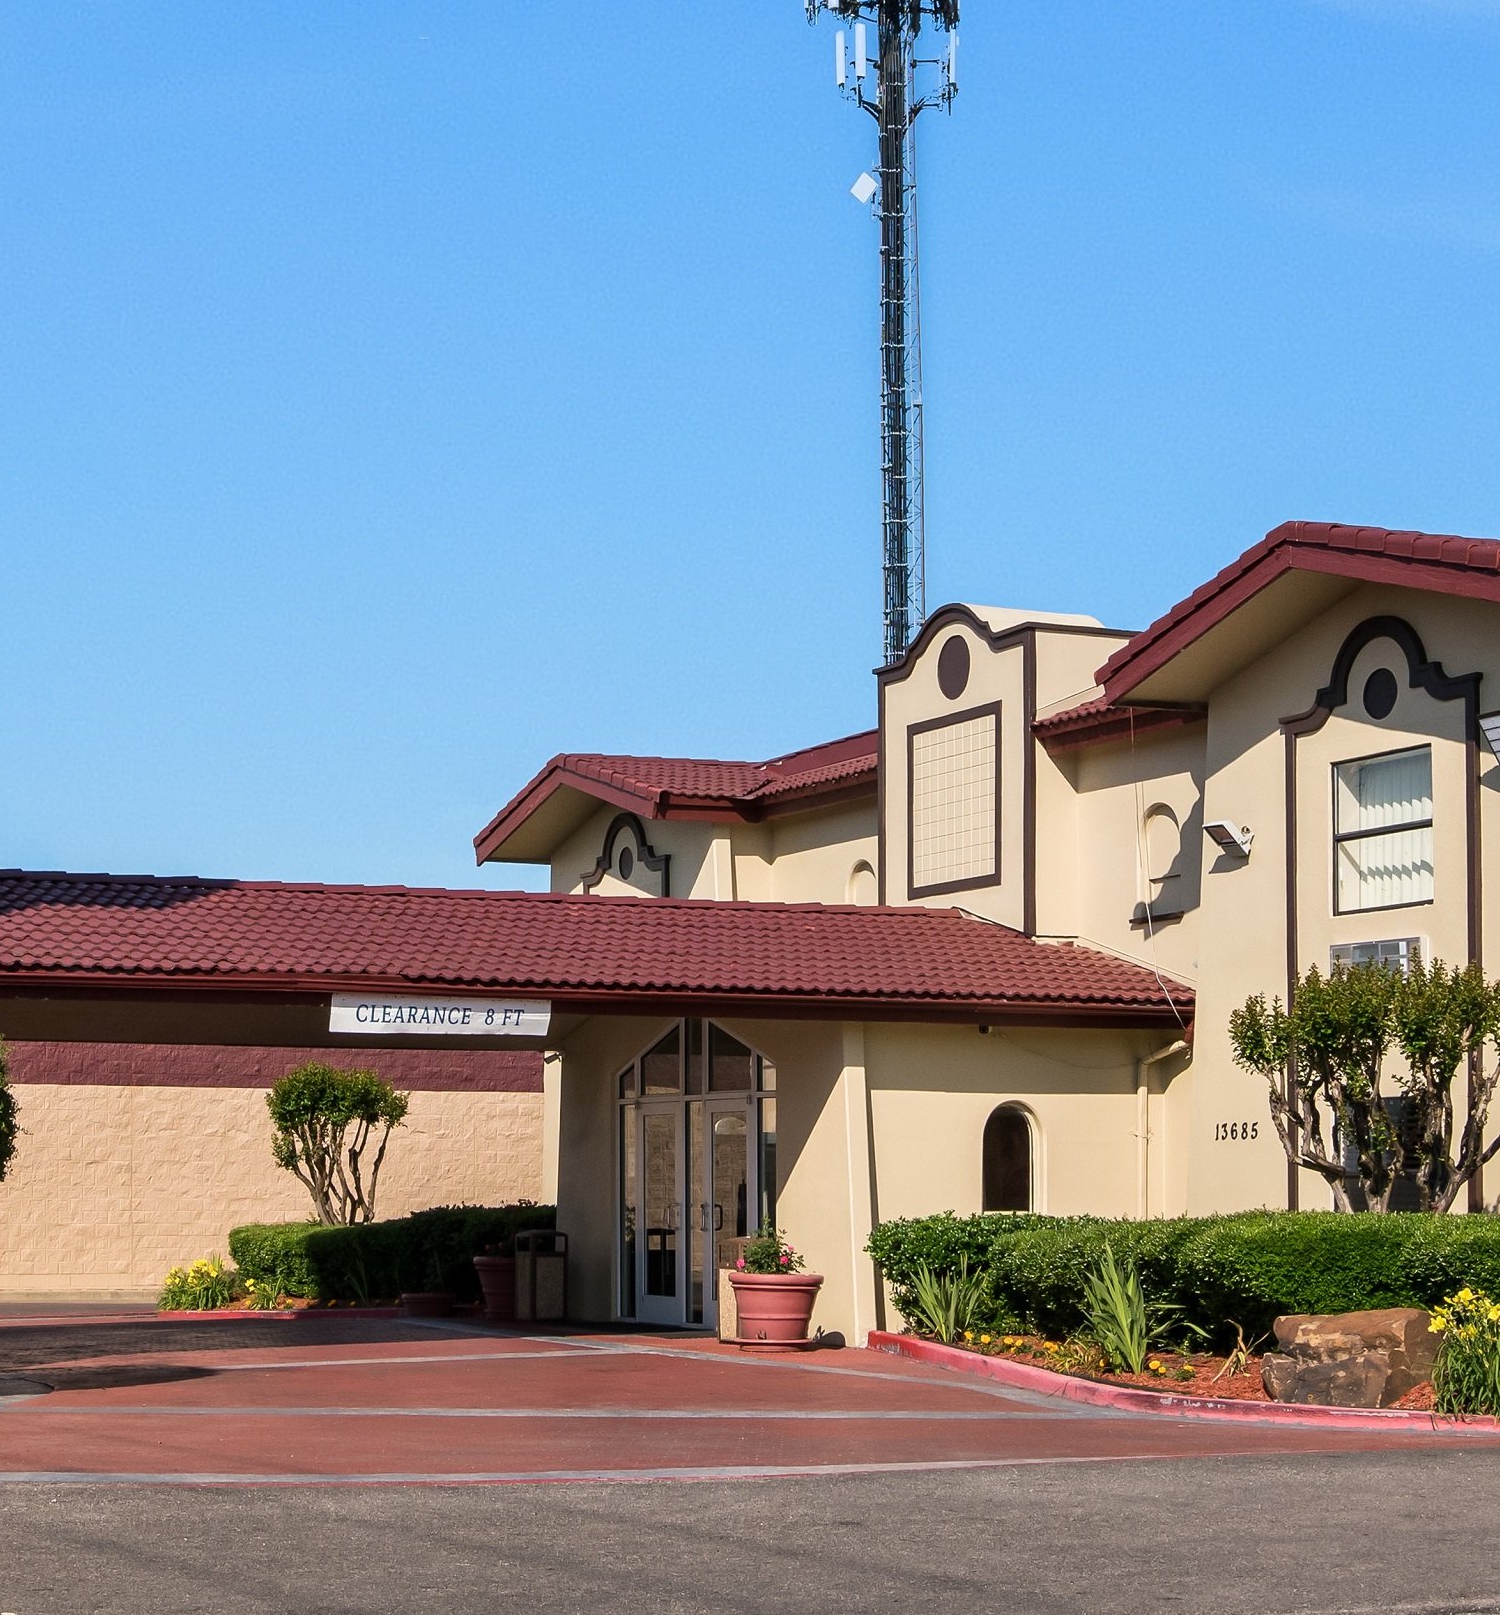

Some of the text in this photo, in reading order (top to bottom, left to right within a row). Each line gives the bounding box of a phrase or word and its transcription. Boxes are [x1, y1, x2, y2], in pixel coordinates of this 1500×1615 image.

[355, 1004, 525, 1026] CLEARANCE 8 FT
[1215, 1122, 1259, 1141] 13685
